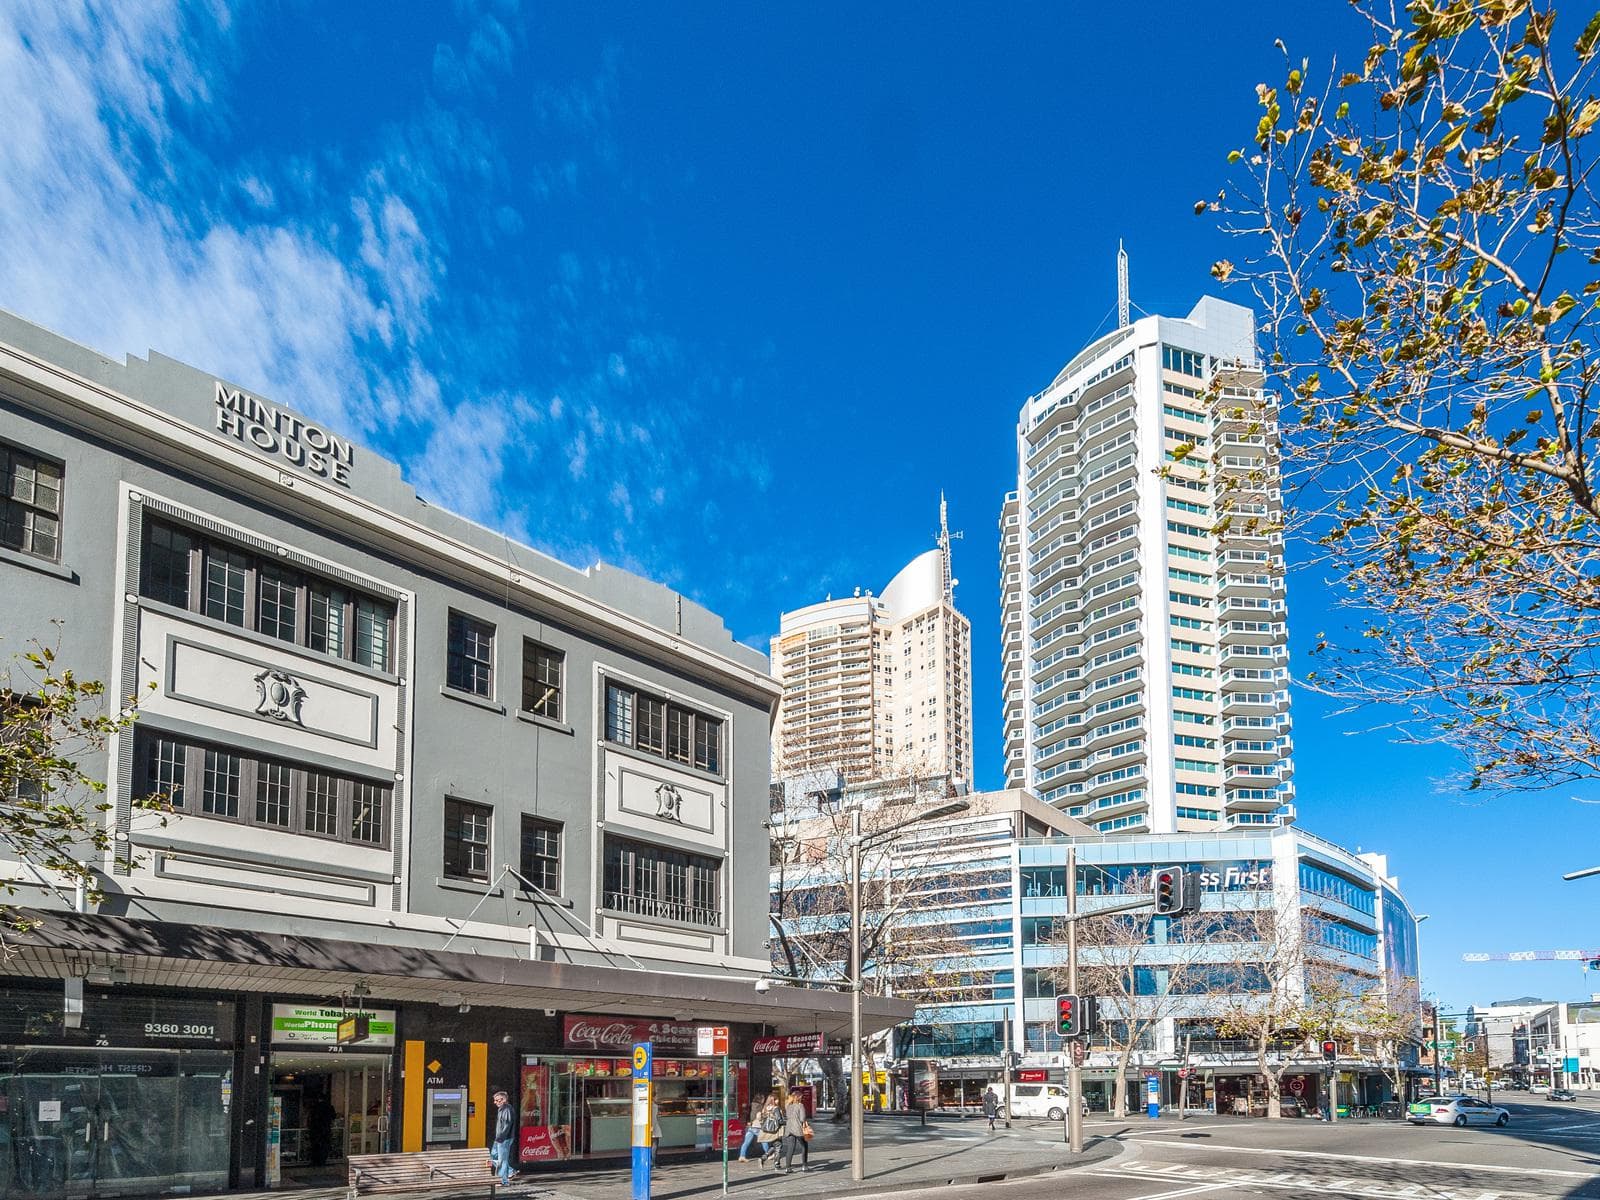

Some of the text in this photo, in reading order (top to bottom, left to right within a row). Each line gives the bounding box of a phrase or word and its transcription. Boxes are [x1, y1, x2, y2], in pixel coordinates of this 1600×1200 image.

[214, 381, 351, 464] MINTON
[215, 406, 351, 487] HOUSE
[1224, 867, 1268, 888] First
[144, 1023, 215, 1035] 9360 3001
